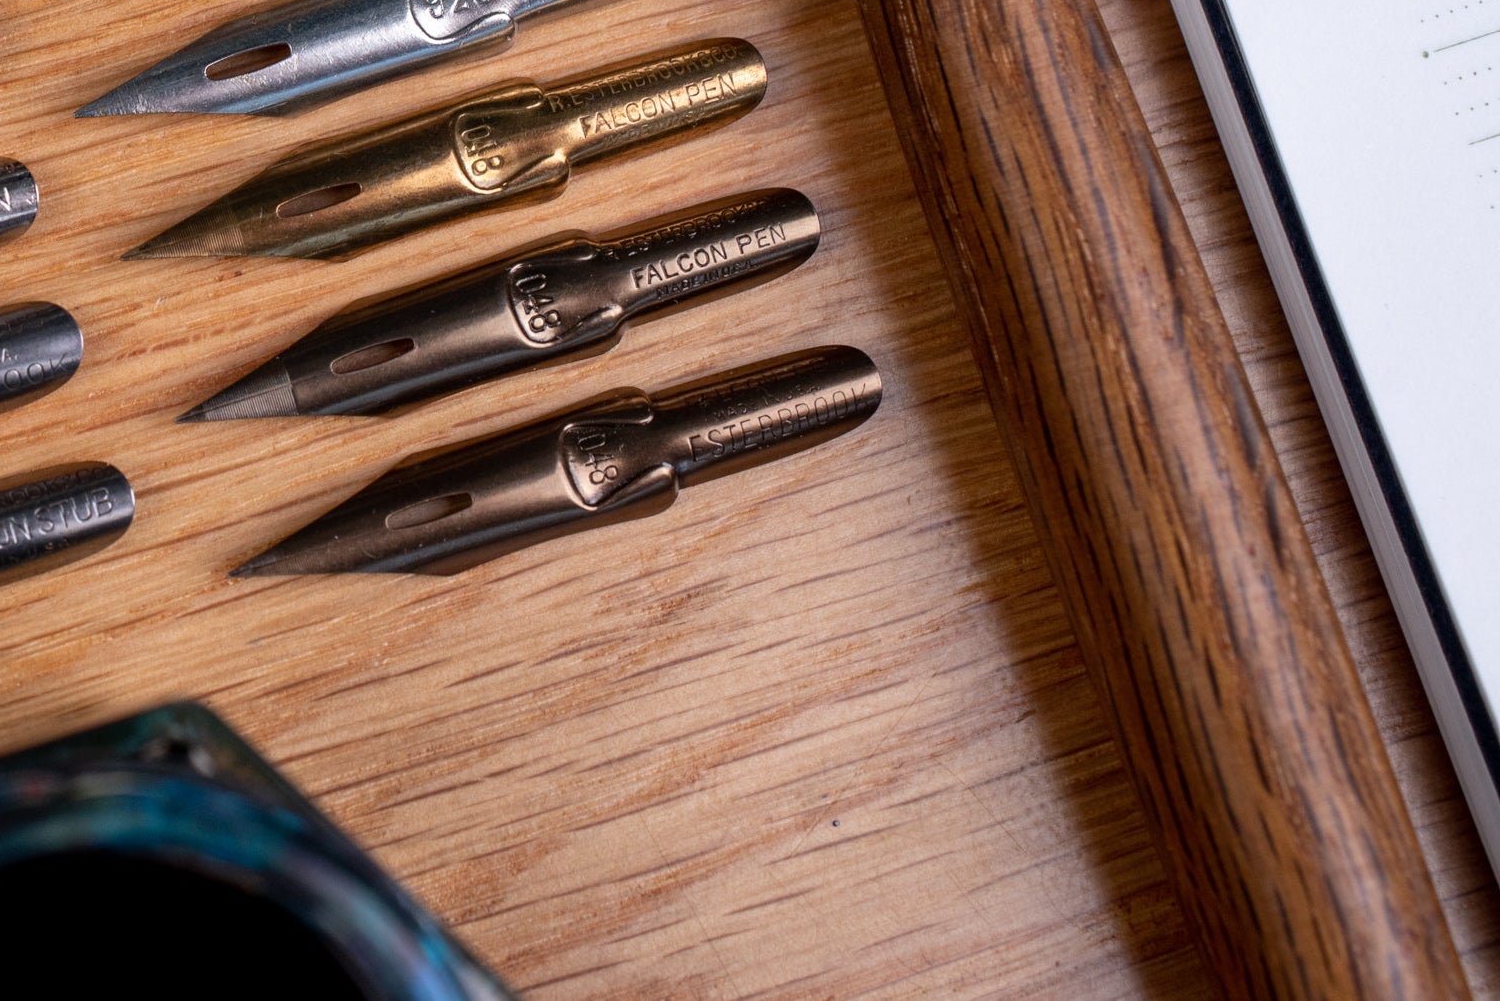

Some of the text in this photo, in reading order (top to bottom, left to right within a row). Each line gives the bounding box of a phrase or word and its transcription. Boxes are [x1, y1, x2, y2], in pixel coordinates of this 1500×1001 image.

[578, 87, 678, 139] FALCON
[684, 71, 739, 107] PEN
[629, 221, 787, 290] FALCON PEN
[514, 271, 562, 334] 048
[687, 382, 875, 463] ESTERBROOK
[577, 431, 618, 486] 048
[33, 486, 115, 534] STUB
